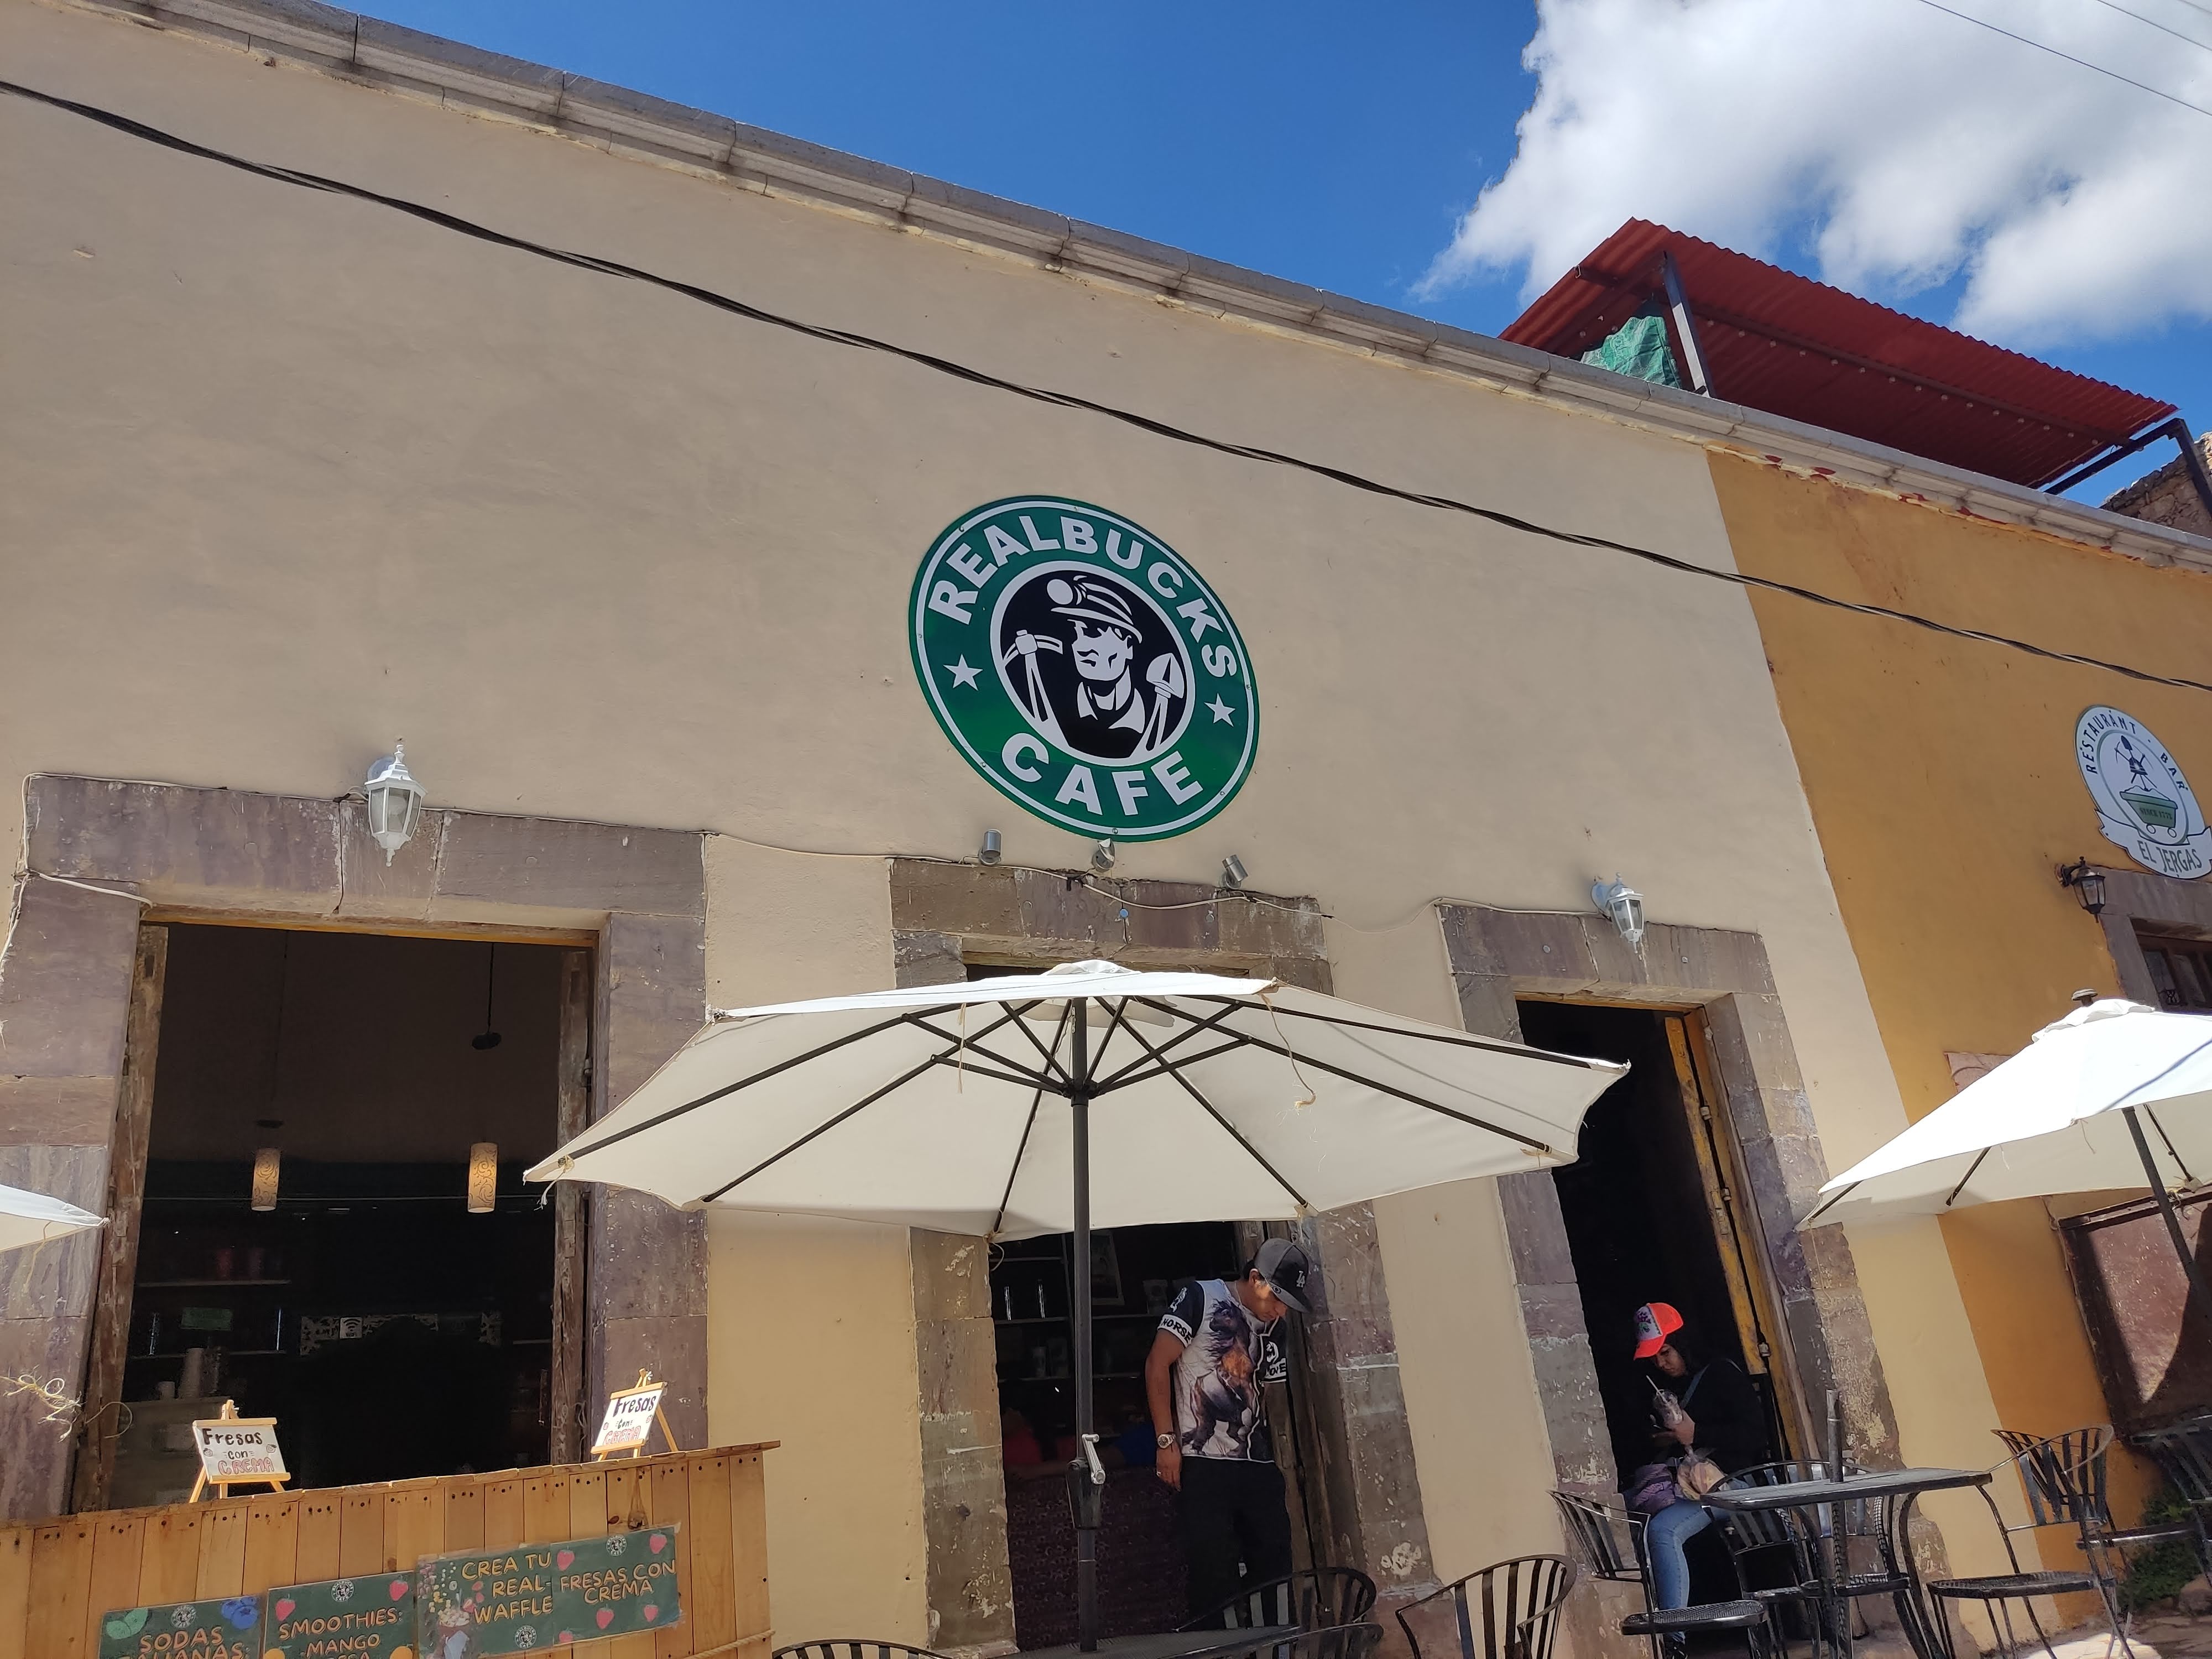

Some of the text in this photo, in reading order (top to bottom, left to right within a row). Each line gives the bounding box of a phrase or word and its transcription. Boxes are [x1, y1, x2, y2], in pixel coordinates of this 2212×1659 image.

[928, 515, 1237, 678] REALBUCKS
[2082, 714, 2136, 774] RESTAURANT
[1001, 732, 1203, 815] CAFE
[2161, 752, 2185, 789] BAR
[2137, 840, 2203, 873] EL JERGAS
[1296, 1270, 1306, 1288] LA
[1161, 1318, 1192, 1343] HORSE
[1266, 1363, 1286, 1376] OVE
[613, 1396, 656, 1417] Fresas
[202, 1428, 263, 1445] Fresas
[603, 1425, 641, 1446] CREMA
[217, 1457, 274, 1475] CREMA
[461, 1552, 551, 1580] CREA TU
[560, 1559, 676, 1593] FRESAS CON
[584, 1579, 654, 1605] CREMA
[279, 1607, 403, 1641] SMOOTHIES:
[474, 1595, 553, 1625] WAFFLE
[139, 1625, 224, 1654] SODAS
